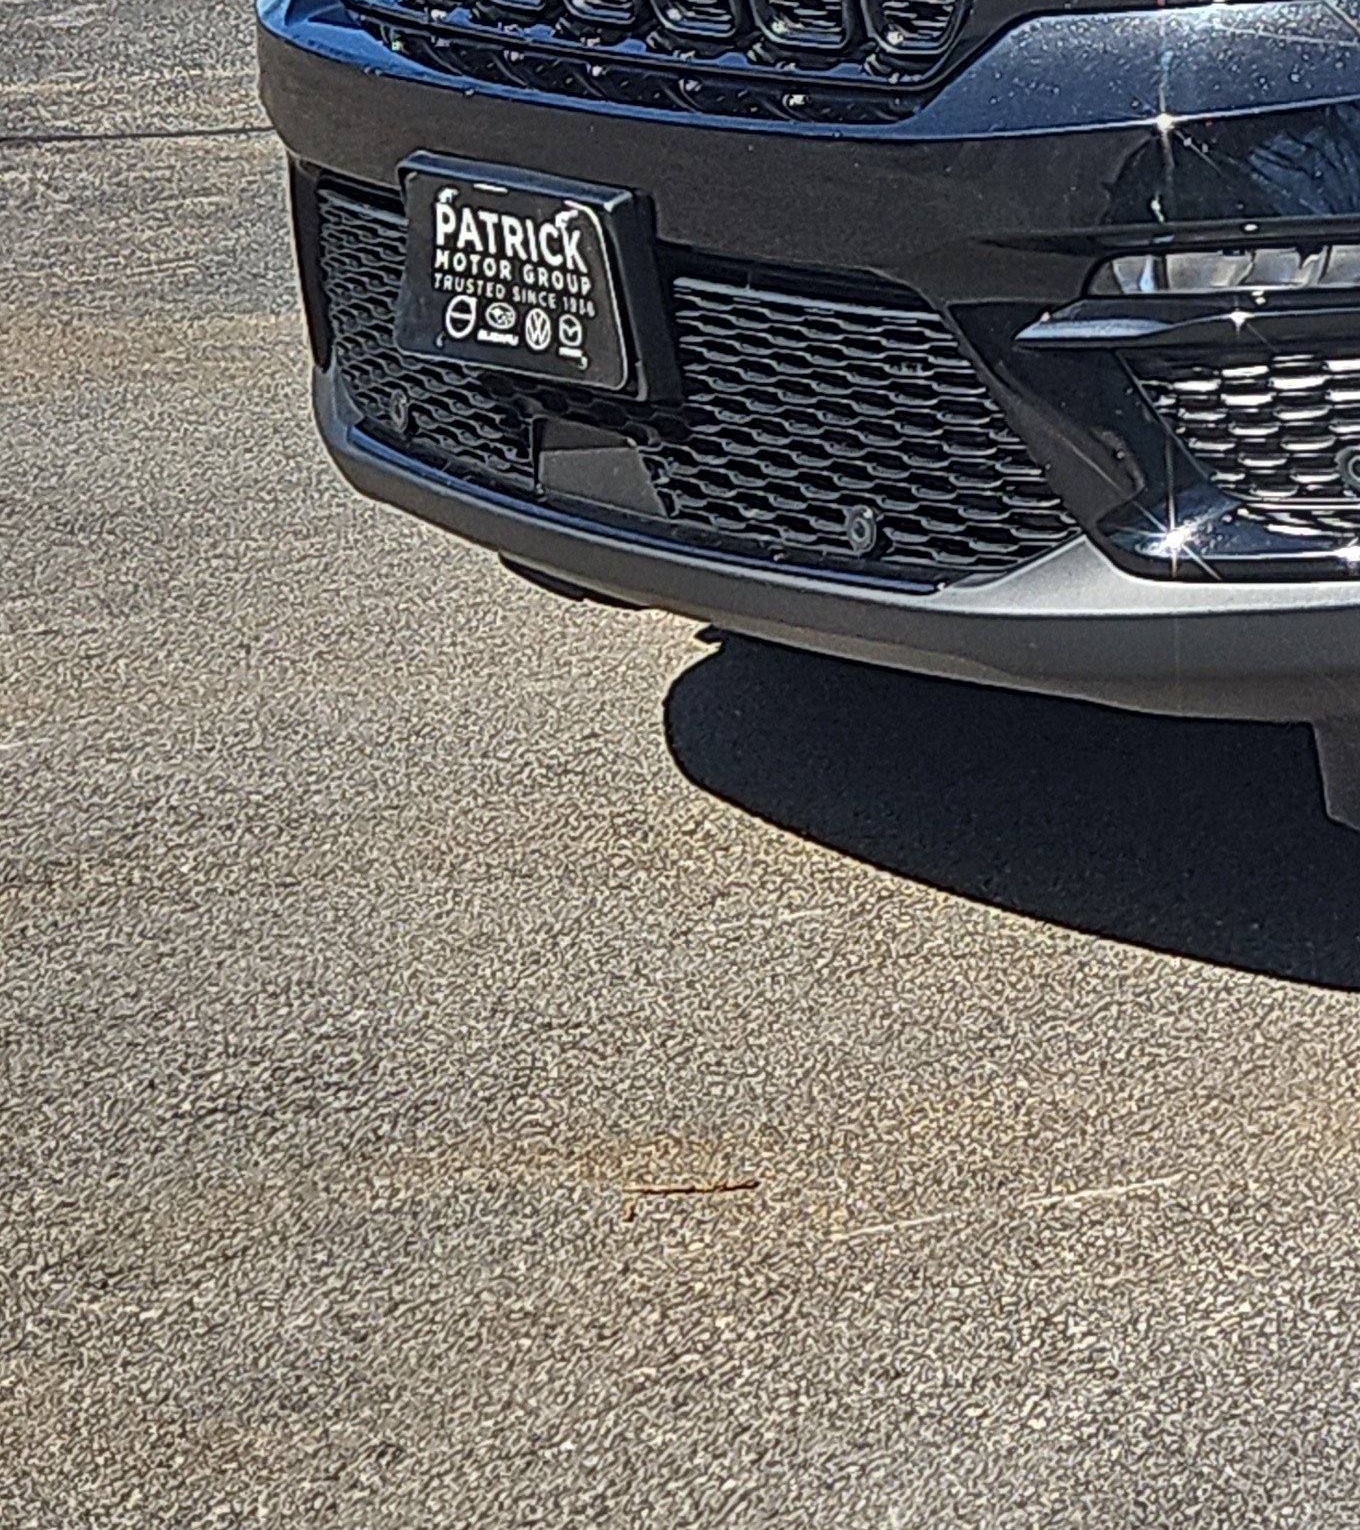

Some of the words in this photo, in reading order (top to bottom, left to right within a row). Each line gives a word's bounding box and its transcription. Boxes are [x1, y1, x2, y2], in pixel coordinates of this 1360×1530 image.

[435, 201, 589, 273] PATRICK
[434, 248, 512, 281] MOTOR
[522, 264, 592, 296] GROUP
[434, 272, 506, 300] TRUSTED
[512, 285, 557, 309] SINCE
